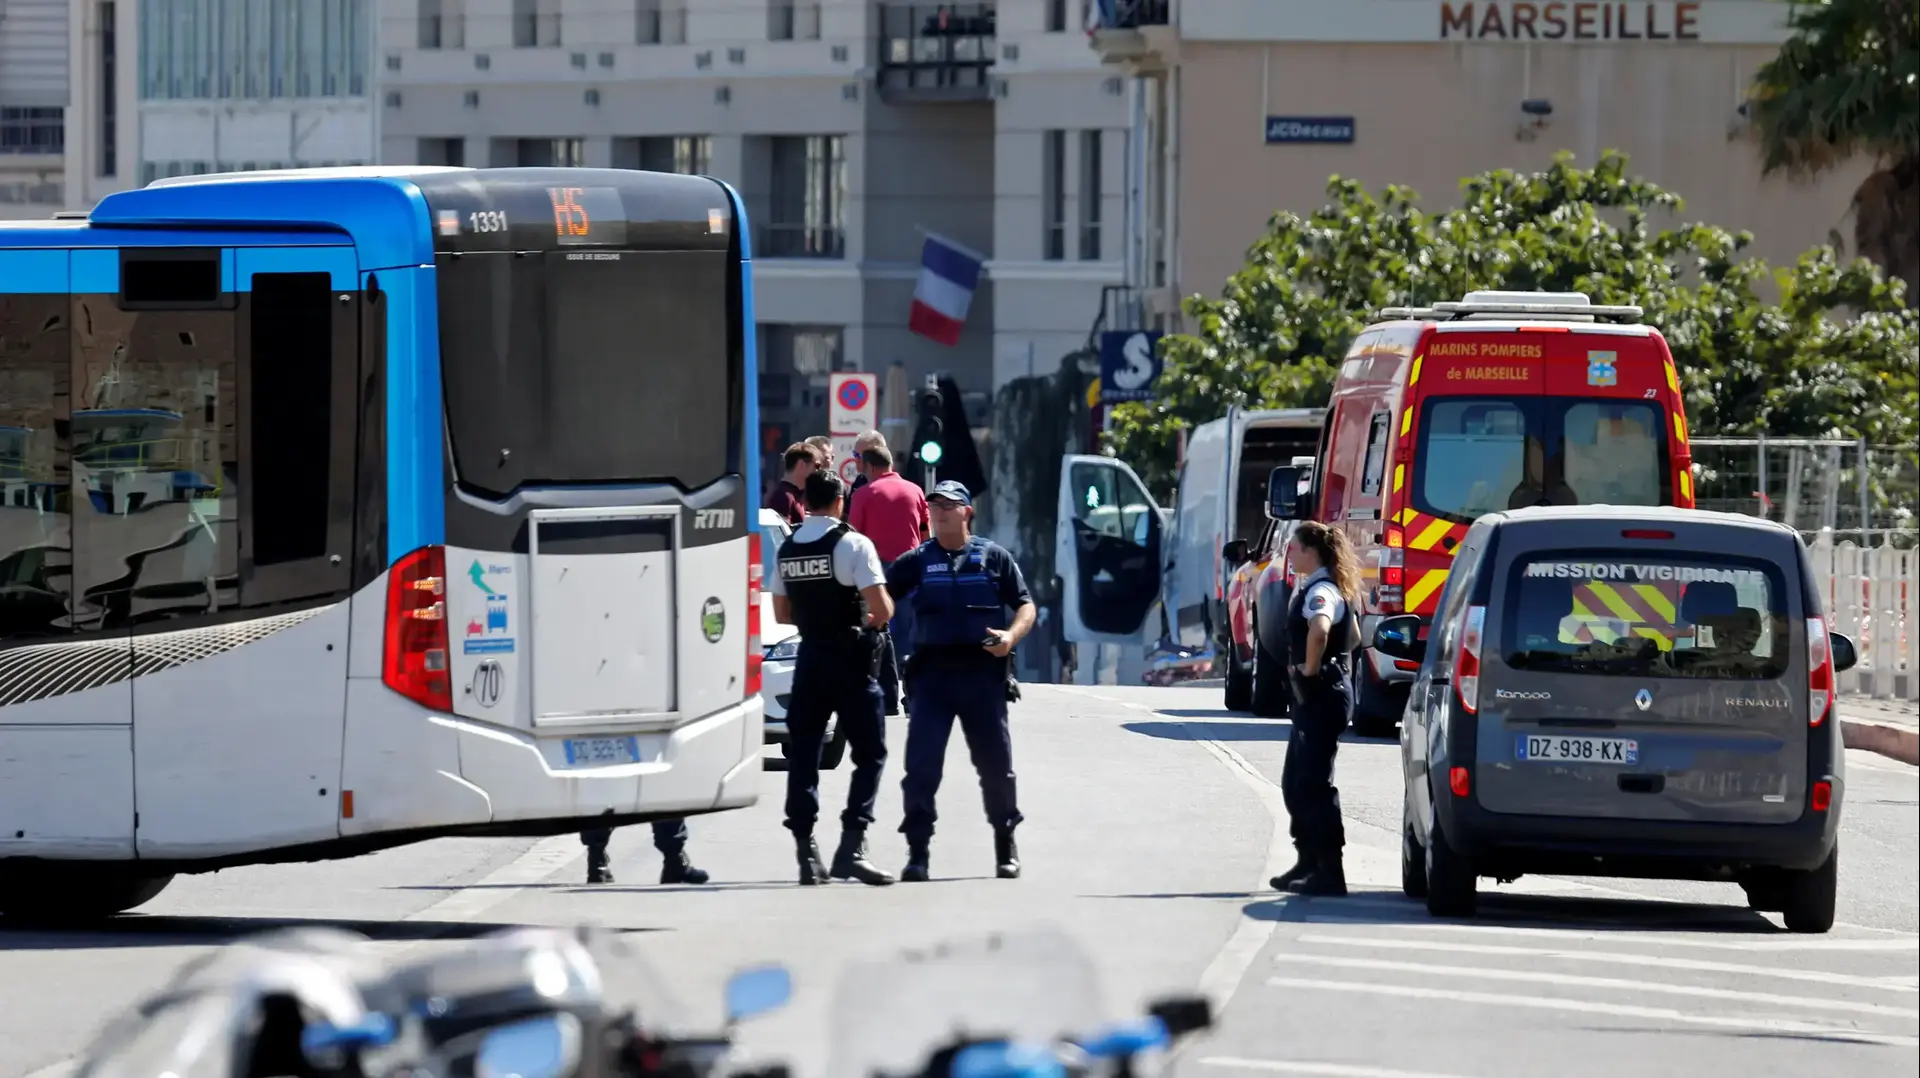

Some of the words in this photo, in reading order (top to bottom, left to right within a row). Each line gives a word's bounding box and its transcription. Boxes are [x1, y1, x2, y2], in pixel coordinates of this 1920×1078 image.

[1440, 1, 1700, 40] MARSEILLE
[1267, 121, 1351, 138] JCDecaux
[552, 187, 589, 236] H5
[469, 210, 508, 233] 1331
[1430, 343, 1477, 357] MARINS
[1481, 344, 1542, 358] POMPIERS
[1446, 367, 1462, 380] de
[1465, 367, 1529, 380] MARSEILLE
[1643, 388, 1657, 399] 23
[780, 558, 830, 578] POLICE
[1527, 562, 1631, 579] MISSION
[478, 663, 499, 702] 70
[1495, 688, 1551, 700] Kangoo
[1724, 697, 1789, 709] RENAULT
[1529, 738, 1624, 761] DZ-938-KX
